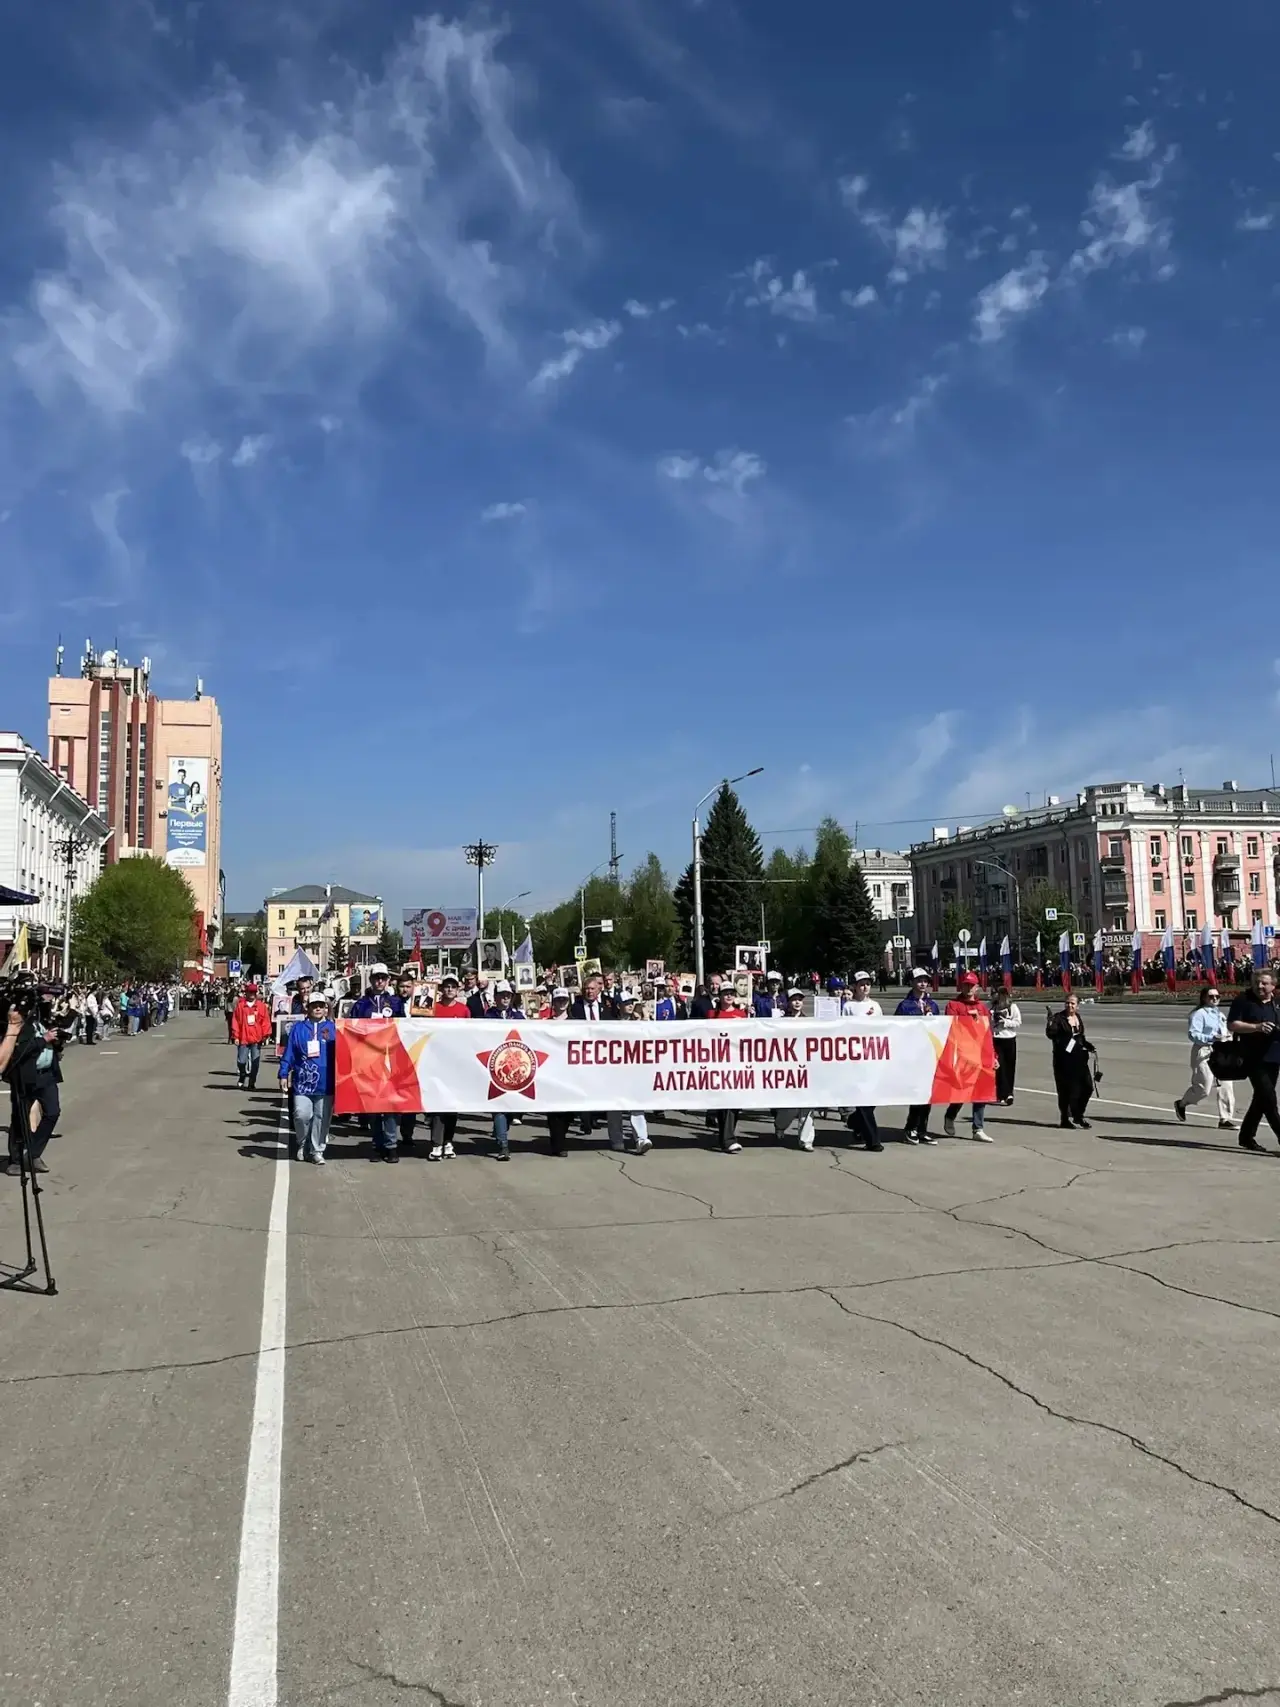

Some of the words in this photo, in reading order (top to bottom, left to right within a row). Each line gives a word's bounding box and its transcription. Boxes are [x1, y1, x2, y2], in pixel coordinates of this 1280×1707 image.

[170, 819, 204, 829] Первые
[232, 961, 240, 970] P
[567, 1032, 731, 1065] БЕССМЕРТНЫЙ
[739, 1037, 798, 1063] ПОЛК
[806, 1036, 890, 1062] РОССИИ
[653, 1065, 755, 1091] АЛТАЙСКИЙ
[762, 1064, 808, 1089] КРАЙ
